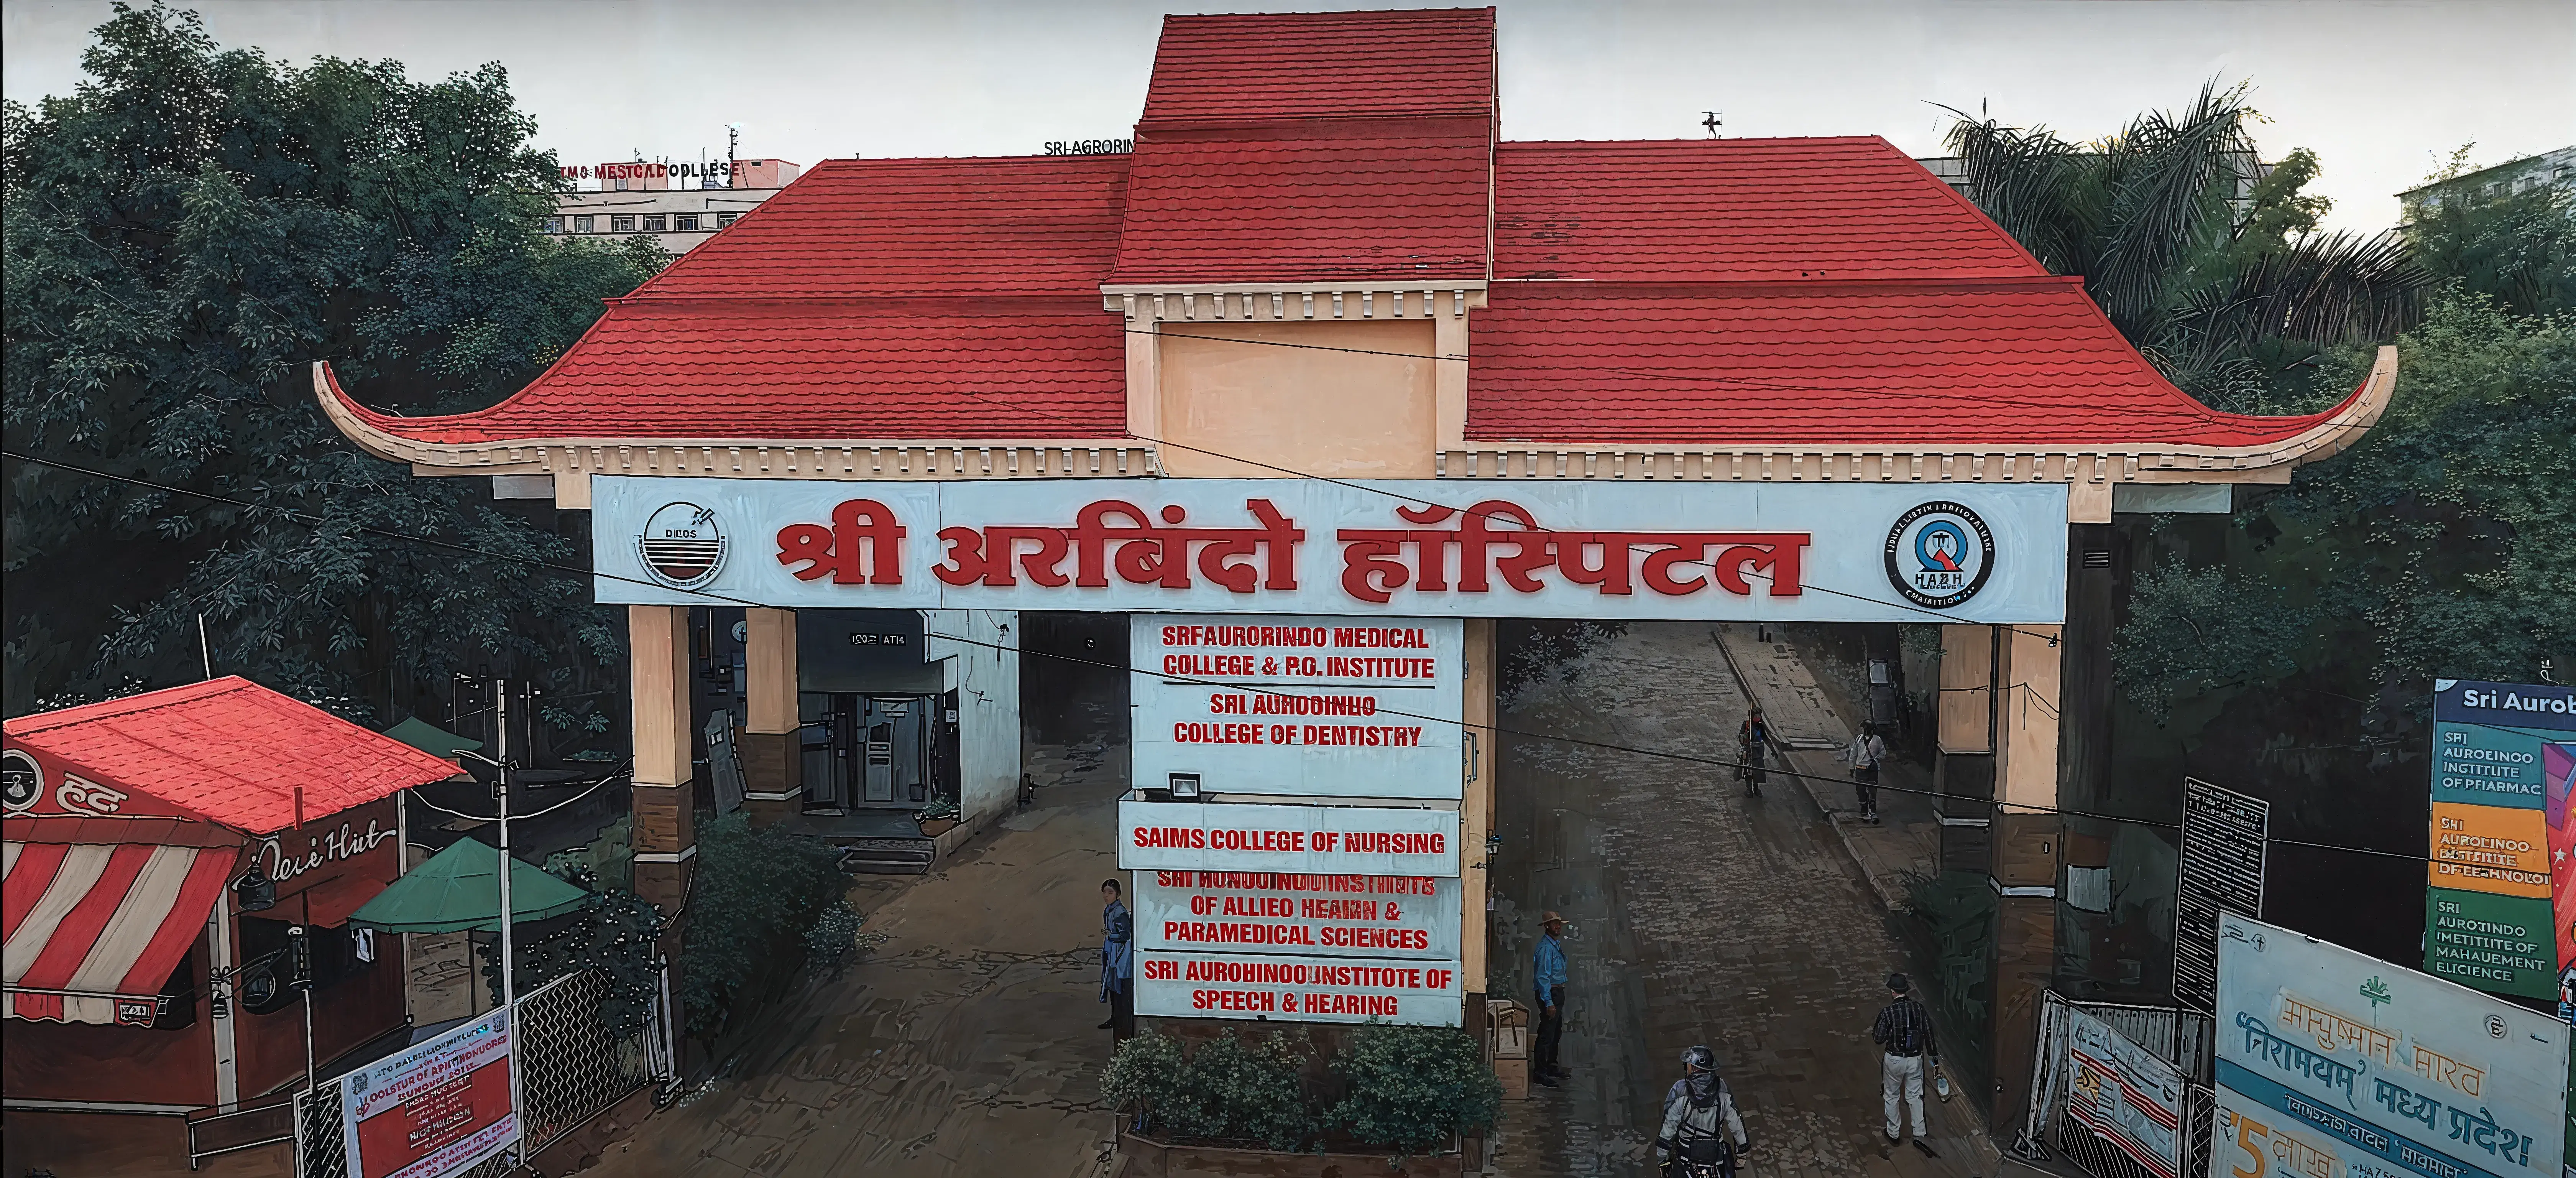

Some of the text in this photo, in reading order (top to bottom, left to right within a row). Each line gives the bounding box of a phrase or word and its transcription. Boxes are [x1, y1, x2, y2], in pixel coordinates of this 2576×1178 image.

[775, 499, 905, 586] श्री
[932, 499, 1305, 594] अरबिंदो
[1336, 500, 1811, 603] हॉस्पिटल
[1334, 627, 1429, 648] MEDICAL
[1163, 654, 1255, 675] COLLEGE
[1261, 656, 1278, 675] &
[1327, 656, 1434, 678] INSTITUTE
[2463, 689, 2497, 709] Sri
[1174, 722, 1422, 747] COLLEGE OF DENTISTRY
[2443, 777, 2463, 788] OF
[1134, 827, 1444, 854] SAIMS COLLEGE OF NURSING
[1191, 895, 1217, 915] OF
[1385, 902, 1401, 921] &
[2438, 902, 2459, 914] SRI
[1165, 921, 1428, 949] PARAMEDICAL SCIENCES
[2515, 942, 2537, 954] OF
[1145, 960, 1178, 980] SRI
[1426, 969, 1452, 989] OF
[1192, 989, 1398, 1016] SPEECH & HEARING
